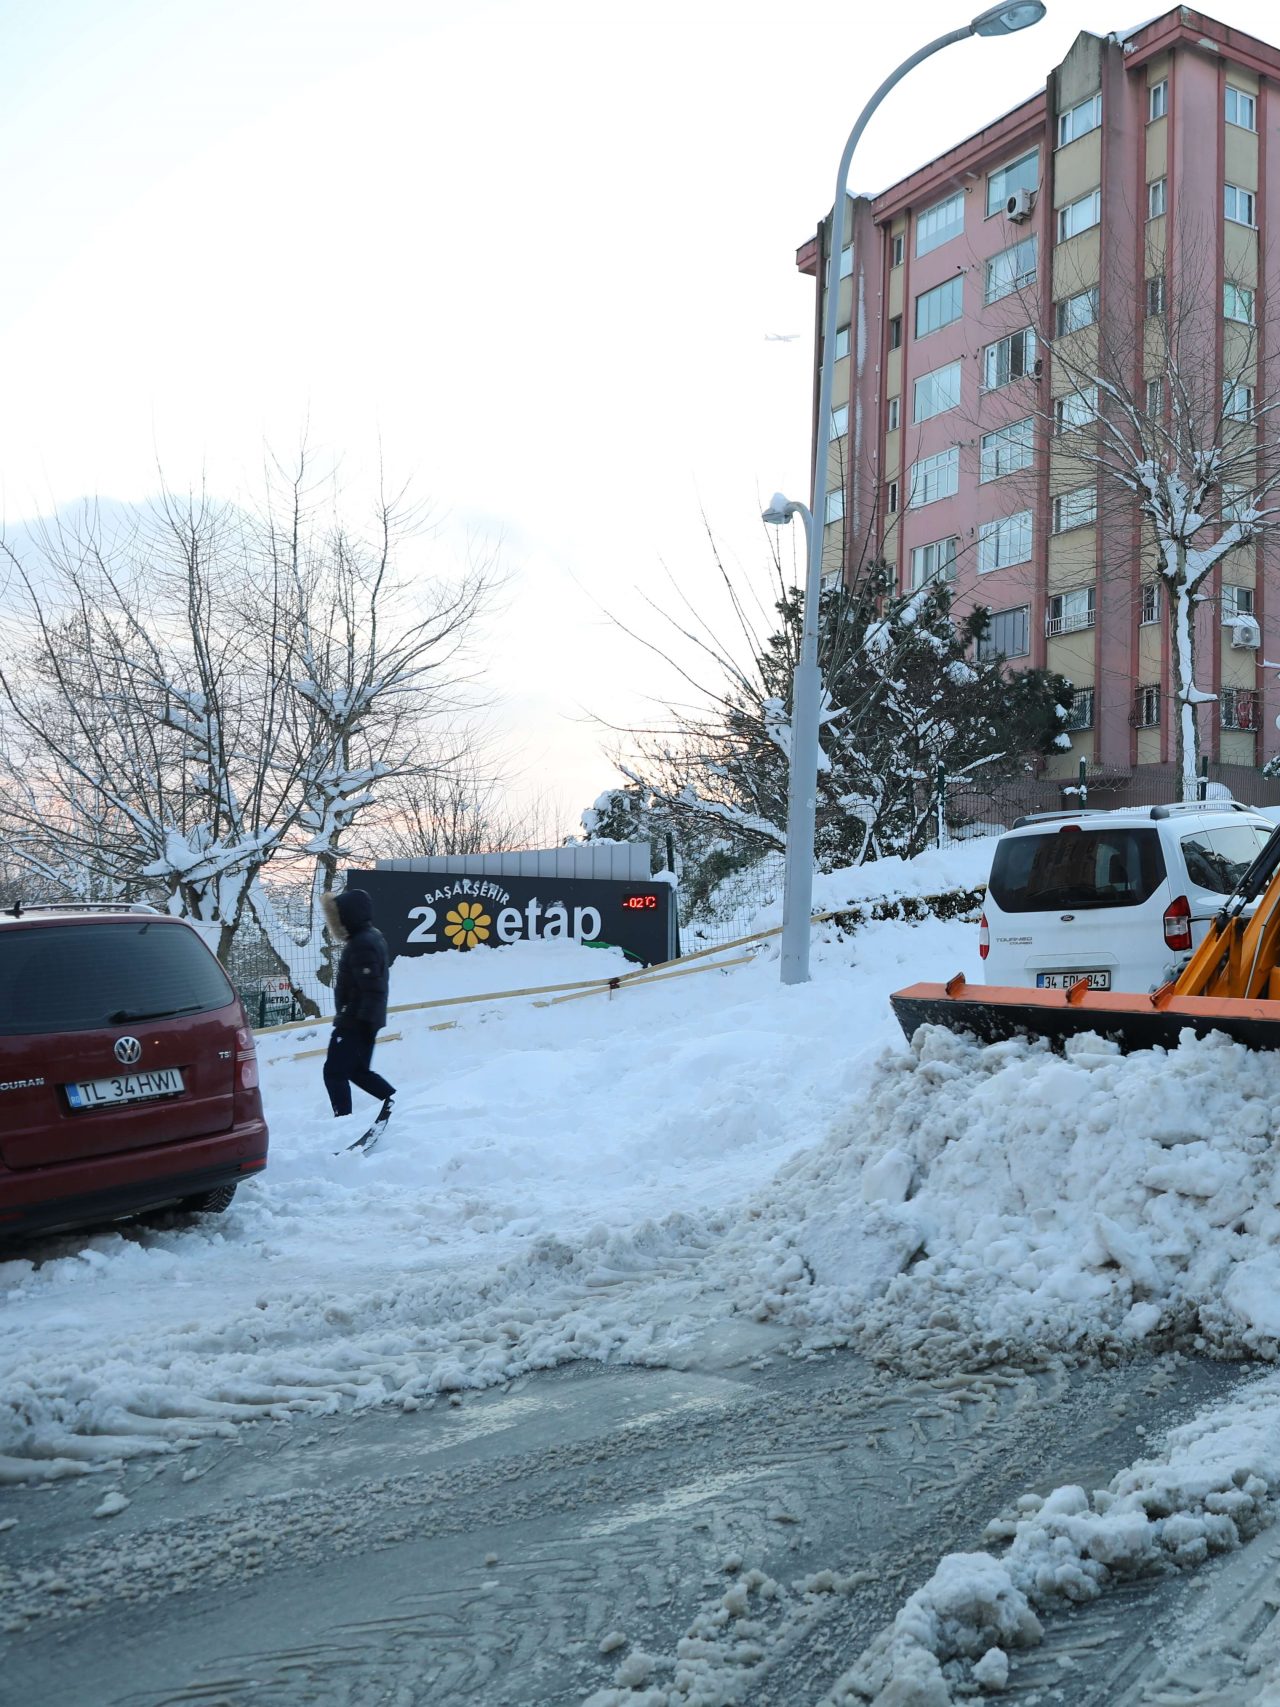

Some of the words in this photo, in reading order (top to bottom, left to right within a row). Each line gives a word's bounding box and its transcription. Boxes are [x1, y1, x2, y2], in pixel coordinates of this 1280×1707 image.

[424, 882, 510, 906] BAŞAKŞEHİR
[406, 906, 437, 943] 2
[496, 897, 601, 945] etap
[1045, 976, 1057, 988] 34
[79, 1082, 106, 1102] TL
[111, 1078, 135, 1097] 34
[136, 1071, 178, 1094] HWI
